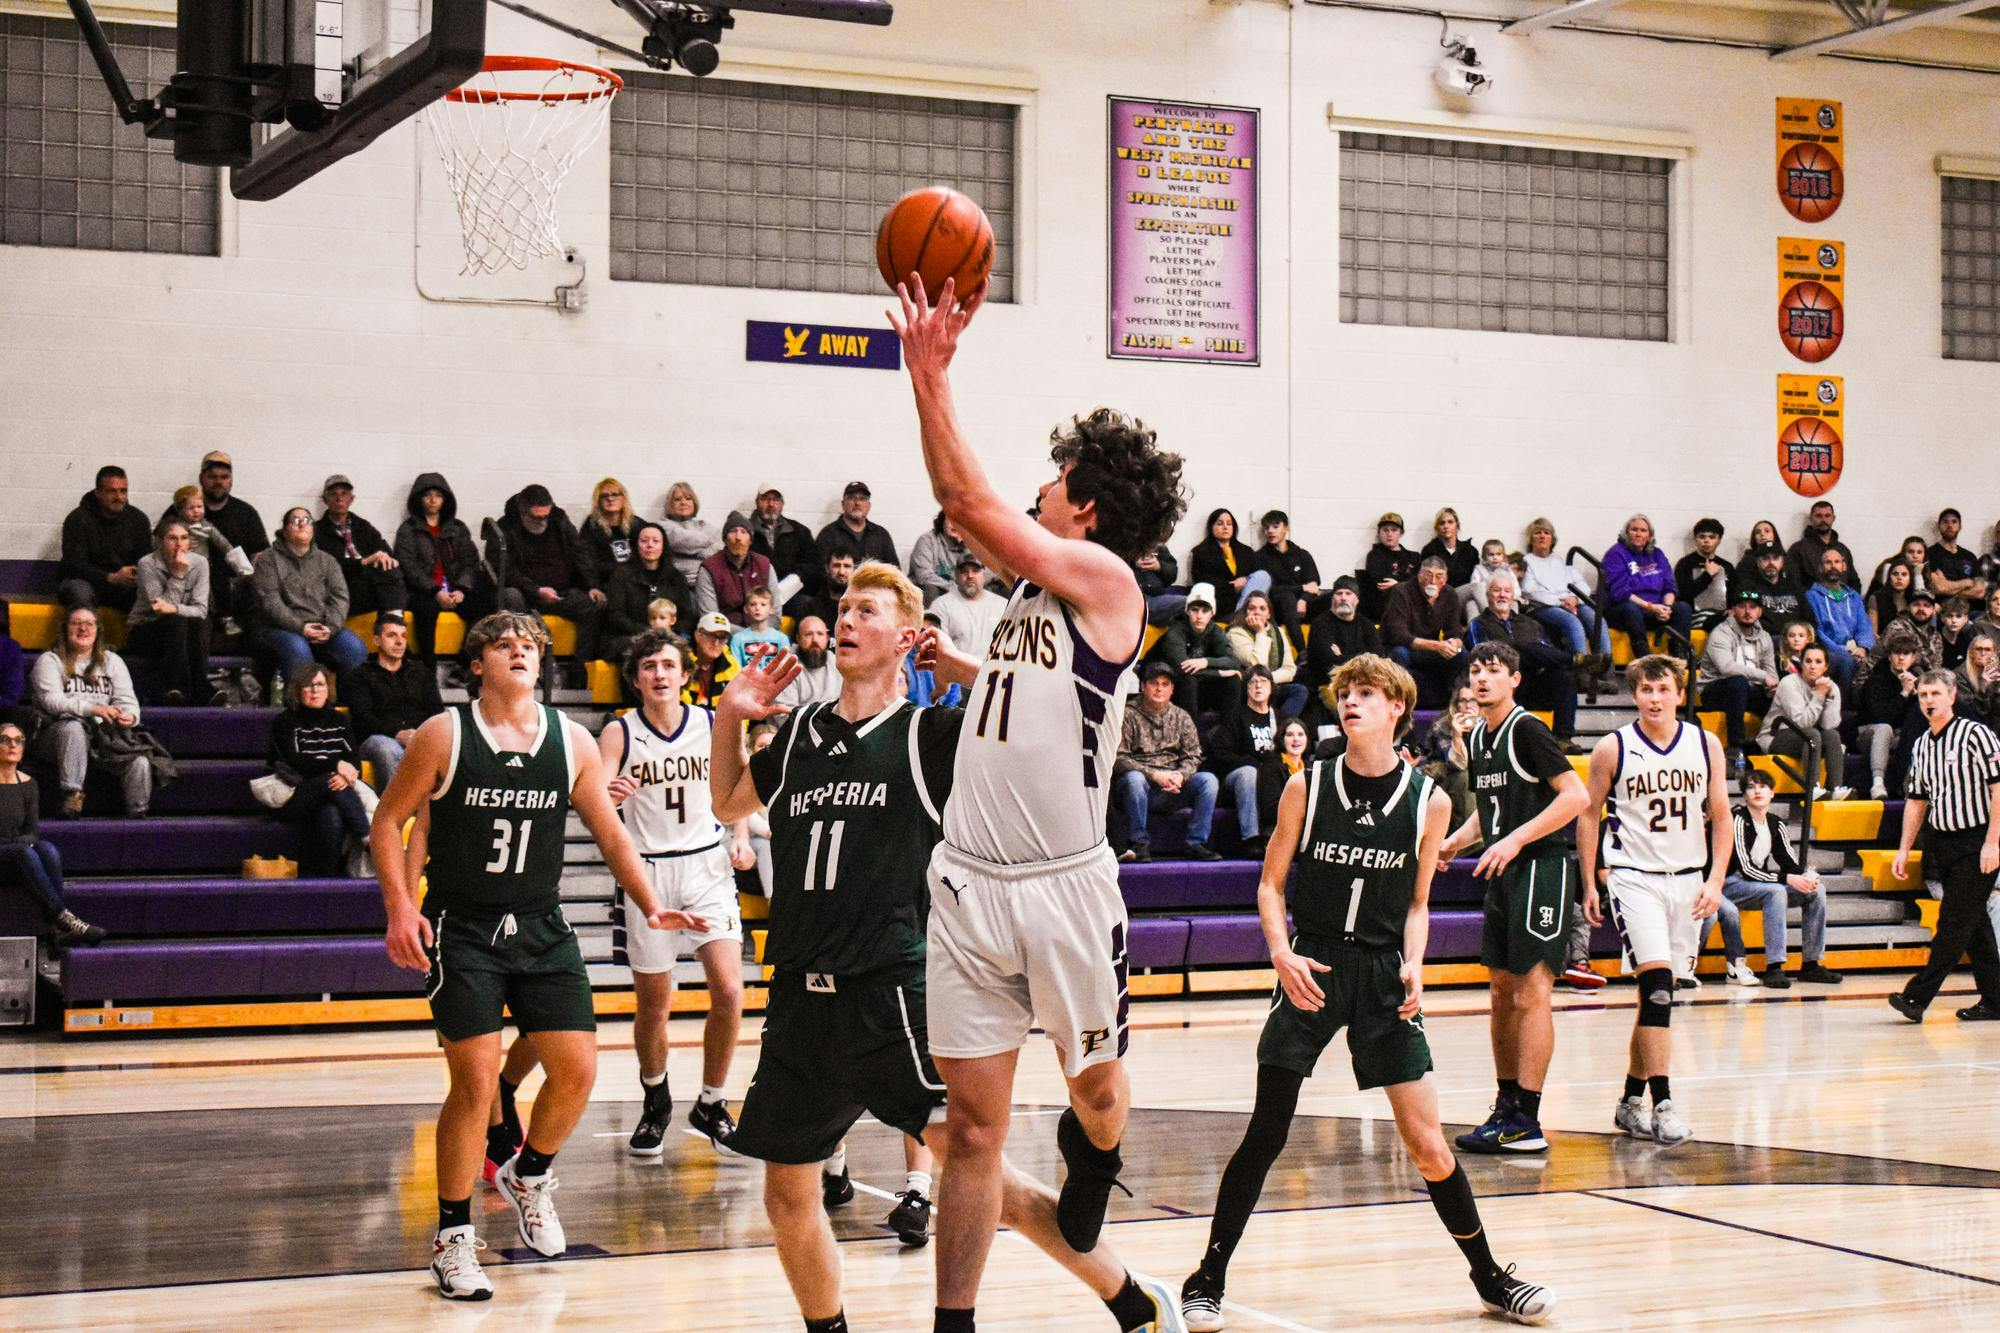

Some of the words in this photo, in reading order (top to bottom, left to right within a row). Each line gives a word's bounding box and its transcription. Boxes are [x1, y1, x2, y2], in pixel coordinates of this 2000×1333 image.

[1153, 107, 1200, 118] WELCOME
[1204, 111, 1216, 119] TO
[1133, 115, 1235, 135] PENTWATER
[1143, 132, 1180, 148] AND
[1189, 136, 1227, 151] THE
[1116, 147, 1163, 162] WEST
[1170, 151, 1252, 168] MICHIGAN
[1137, 165, 1150, 178] D
[1157, 166, 1231, 184] LEAGUE
[1168, 184, 1201, 193] WHERE
[1126, 191, 1240, 211] SPORTSMANSHIP
[1160, 235, 1172, 243] SO
[1175, 236, 1209, 246] PLEASE
[1149, 256, 1190, 266] PLAYERS
[1166, 247, 1182, 255] LET
[1186, 247, 1203, 255] THE
[1145, 276, 1187, 286] COACHES
[1186, 269, 1202, 277] THE
[1134, 296, 1182, 306] OFFICIALS
[1166, 288, 1182, 296] LET
[1186, 289, 1202, 297] THE
[1125, 317, 1181, 328] SPECTATORS
[1166, 308, 1182, 316] LET
[1186, 309, 1202, 318] THE
[1791, 316, 1829, 336] 2017
[819, 333, 869, 358] AWAY
[1121, 333, 1172, 350] FALCON
[1205, 337, 1246, 353] PRIDE
[976, 669, 1015, 742] 11
[631, 756, 709, 788] FALCONS
[1626, 769, 1702, 800] FALCONS
[464, 787, 558, 809] HESPERIA
[665, 786, 685, 824] 4
[790, 781, 887, 818] HESPERIA
[1489, 795, 1500, 835] 2
[1649, 796, 1687, 832] 24
[485, 818, 533, 874] 31
[804, 820, 845, 891] 11
[1313, 841, 1407, 869] HESPERIA
[1344, 878, 1365, 932] 1
[1080, 1027, 1110, 1058] P
